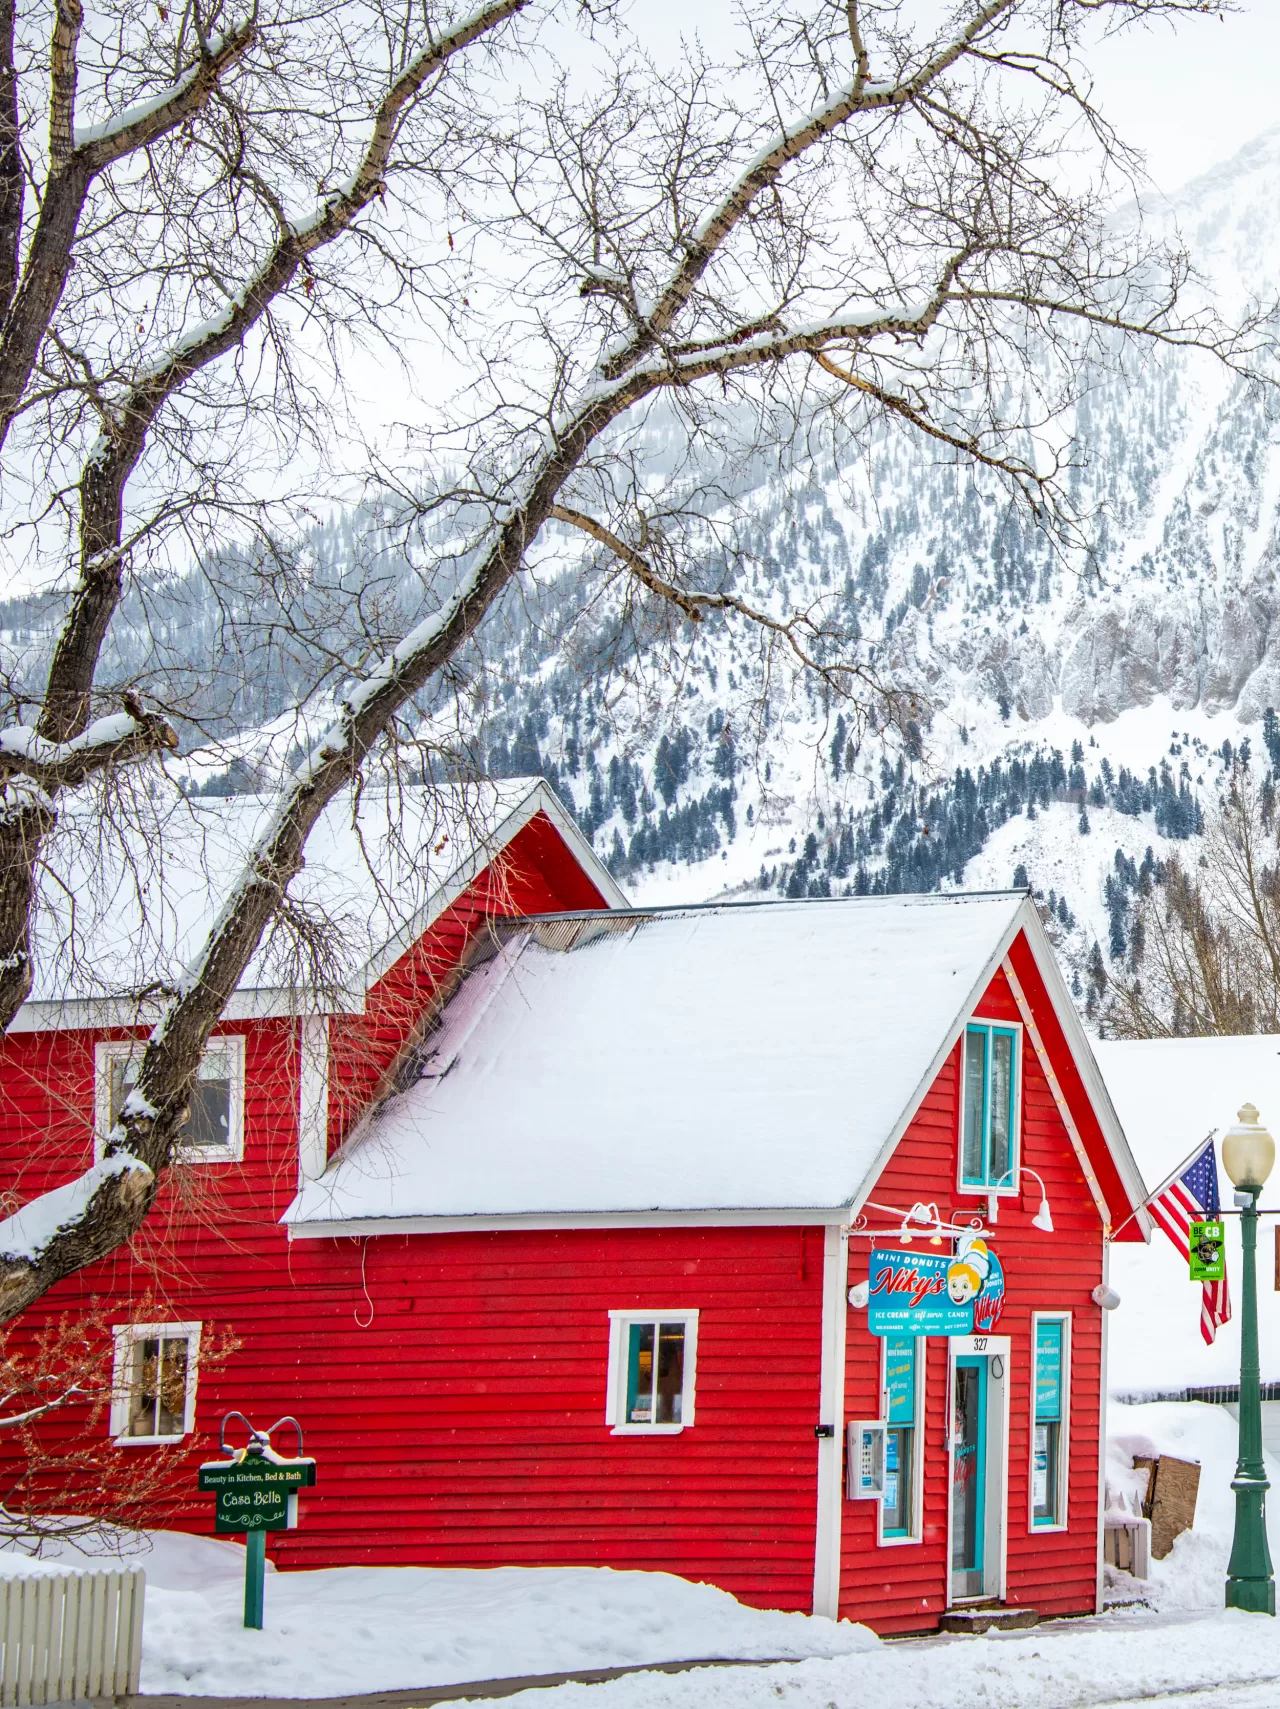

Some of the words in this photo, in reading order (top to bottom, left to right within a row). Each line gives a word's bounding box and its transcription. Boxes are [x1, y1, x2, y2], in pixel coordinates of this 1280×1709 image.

[1194, 1226, 1203, 1234] BE
[1205, 1226, 1220, 1238] CB
[876, 1252, 900, 1262] MINI
[904, 1256, 946, 1268] DONUTS
[870, 1266, 947, 1308] Niky's
[972, 1338, 988, 1351] 327
[204, 1476, 227, 1484] Beauty
[236, 1474, 263, 1482] Kitchen,
[265, 1472, 278, 1480] Bed
[286, 1472, 301, 1480] Bath
[223, 1492, 251, 1507] Casa
[254, 1491, 281, 1505] Bella
